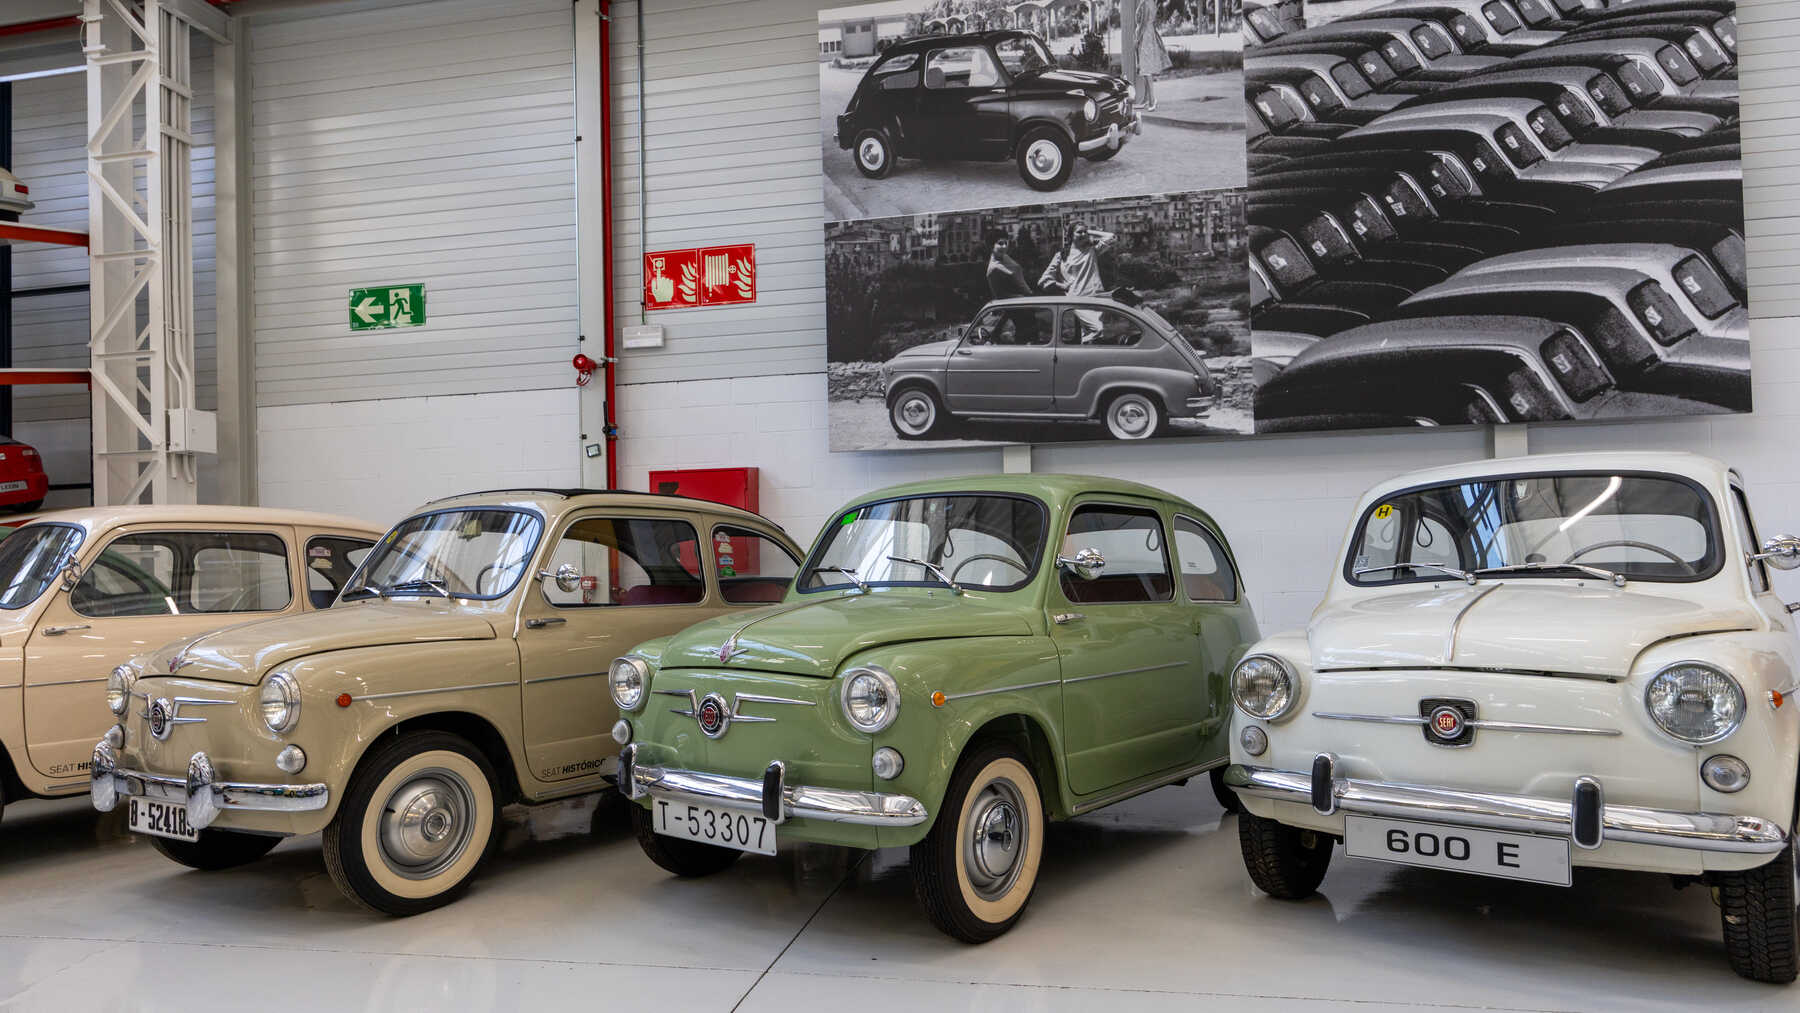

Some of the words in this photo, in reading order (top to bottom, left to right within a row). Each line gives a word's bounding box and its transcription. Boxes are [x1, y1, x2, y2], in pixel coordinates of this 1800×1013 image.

[1378, 506, 1391, 518] H
[1439, 717, 1455, 729] SEAT
[49, 763, 75, 775] SEAT
[542, 767, 561, 778] SEAT
[658, 800, 767, 849] T-53307
[1386, 829, 1471, 861] 600
[1496, 841, 1521, 868] E
